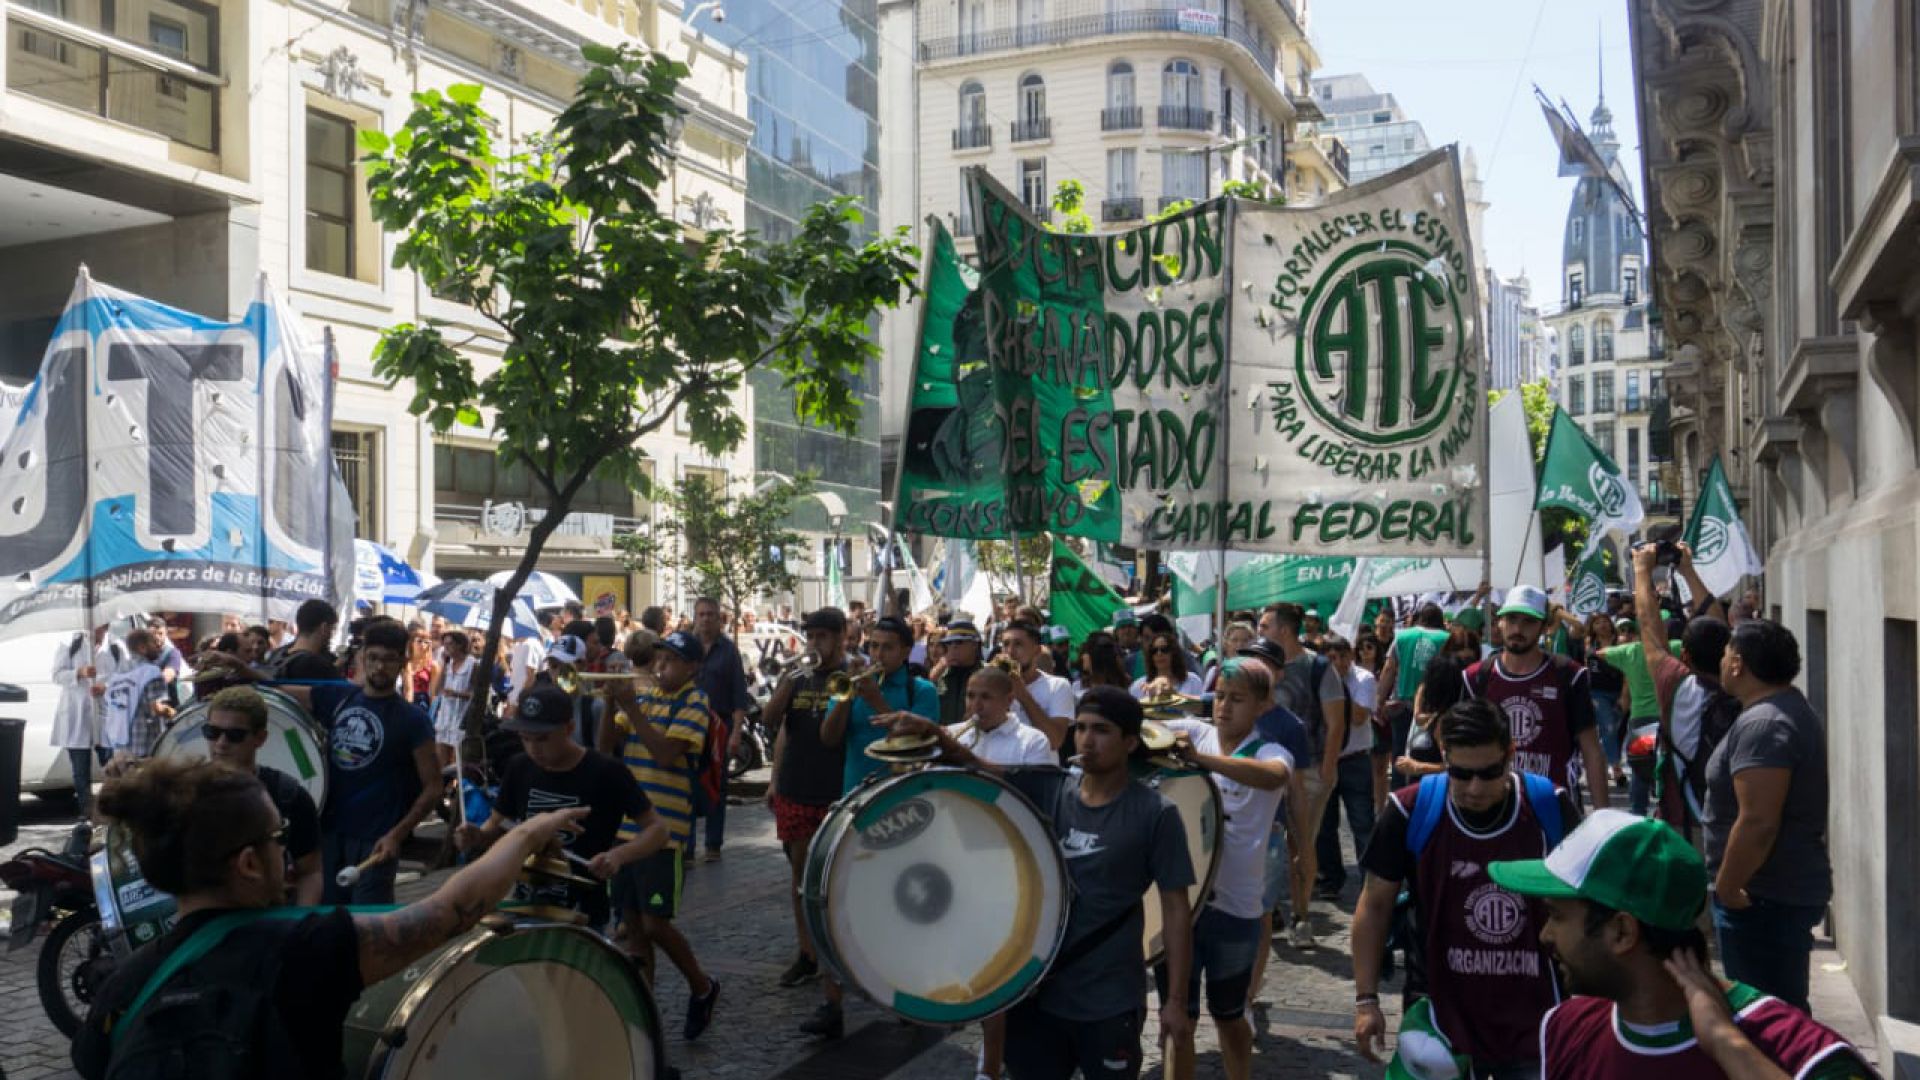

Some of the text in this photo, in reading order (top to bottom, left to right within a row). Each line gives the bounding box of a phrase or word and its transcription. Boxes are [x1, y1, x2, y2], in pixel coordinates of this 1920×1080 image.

[1269, 208, 1468, 311] FORTALECER EL ESTADO
[1312, 258, 1449, 428] ATE
[1062, 408, 1217, 490] ESTADO
[1267, 382, 1305, 442] PARA
[1297, 434, 1403, 482] LIBERAR
[1408, 446, 1435, 481] LA
[1150, 501, 1275, 542] CAPITAL
[1293, 495, 1475, 545] FEDERAL
[201, 562, 225, 582] de
[229, 566, 244, 584] la
[1297, 567, 1322, 582] EN
